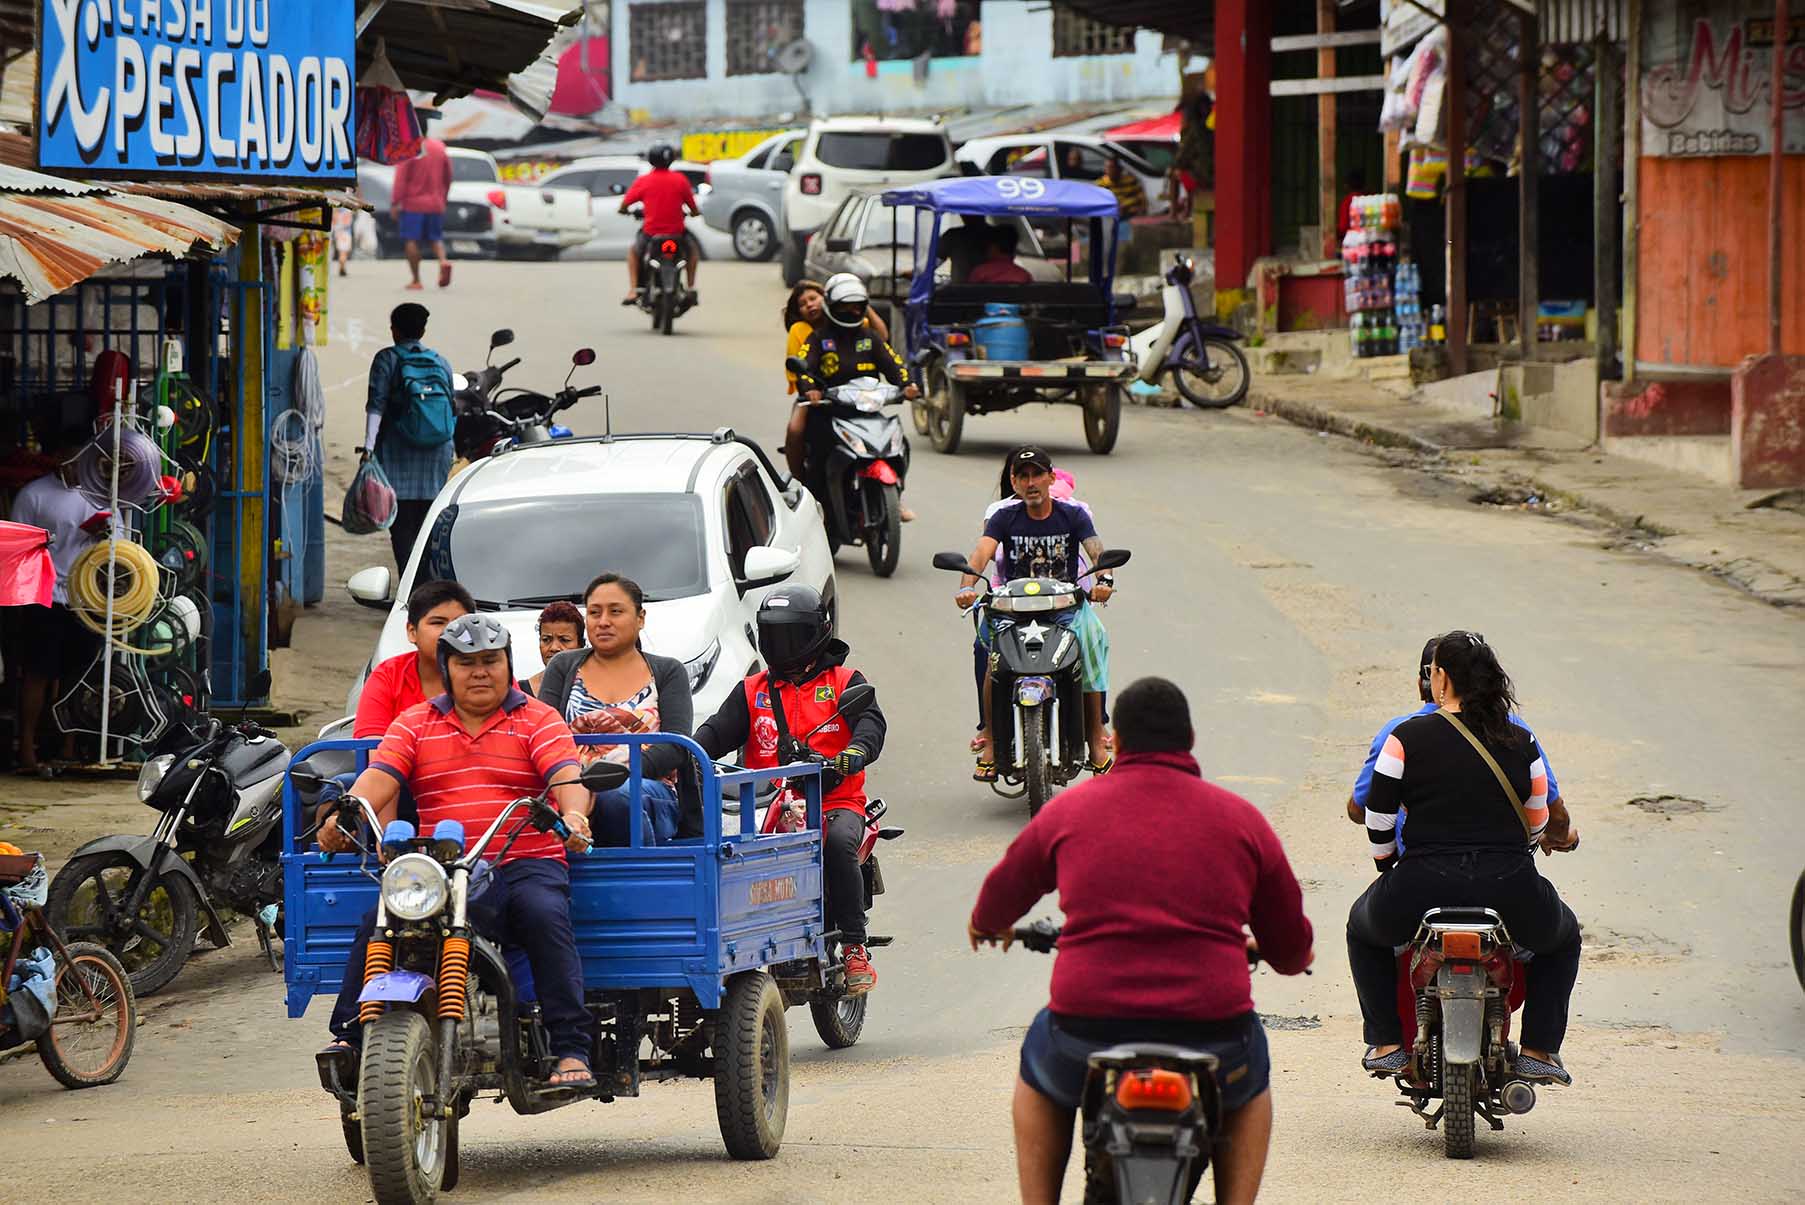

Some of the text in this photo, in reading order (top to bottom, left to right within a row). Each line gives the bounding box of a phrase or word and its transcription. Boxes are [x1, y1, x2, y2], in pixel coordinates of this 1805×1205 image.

[115, 36, 353, 166] PESCADOR
[1669, 129, 1760, 155] Bebidas
[996, 177, 1045, 199] 99
[1010, 533, 1070, 560] JUSTICE
